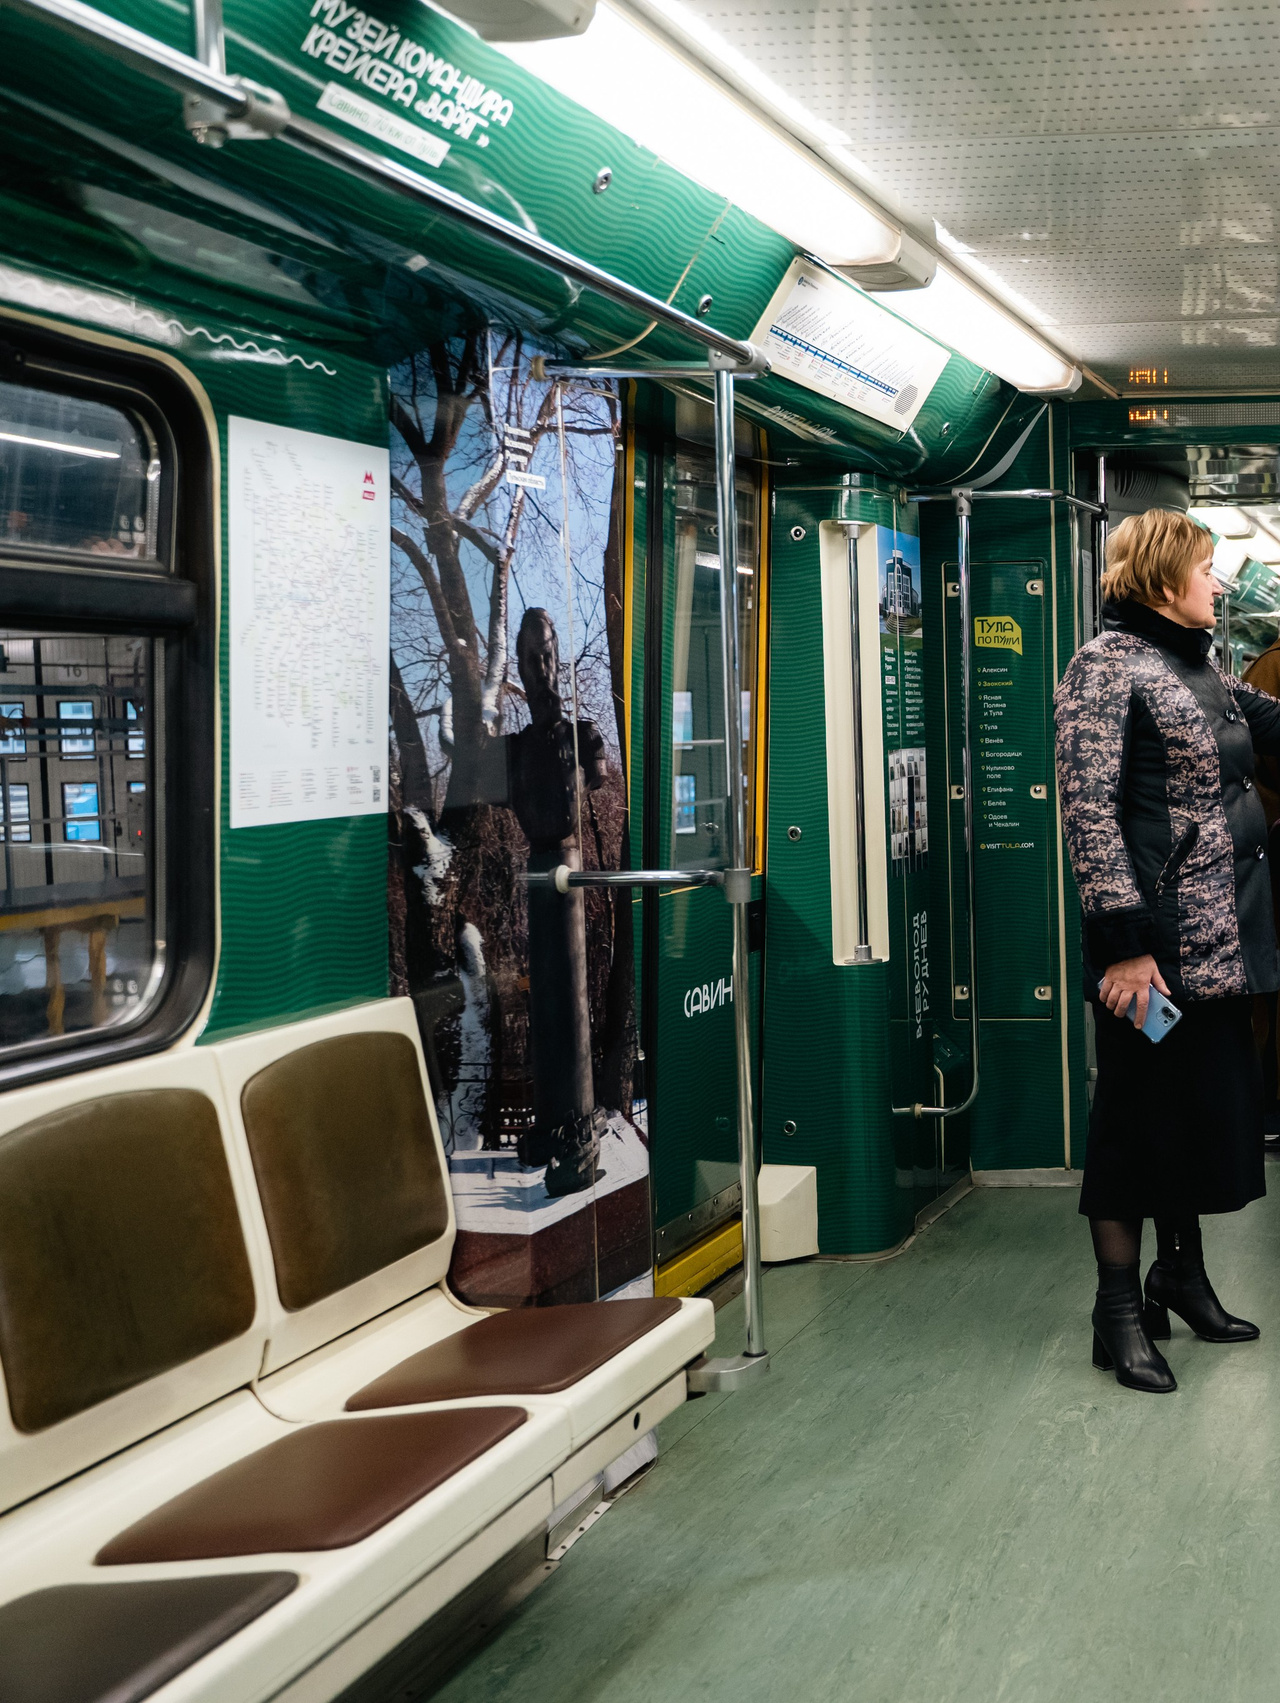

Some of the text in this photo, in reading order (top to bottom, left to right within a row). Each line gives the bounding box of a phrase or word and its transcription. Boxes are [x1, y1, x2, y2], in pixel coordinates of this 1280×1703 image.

[300, 22, 418, 107] КРЕЙСЕРА
[309, 0, 514, 128] МУЗЕЙ КОМАНДИРА
[986, 842, 1035, 850] VISITTULA.COM
[684, 975, 733, 1018] САВИН
[912, 912, 923, 1039] ВСЕВОЛОД
[920, 910, 930, 1012] РУДНЕВ
